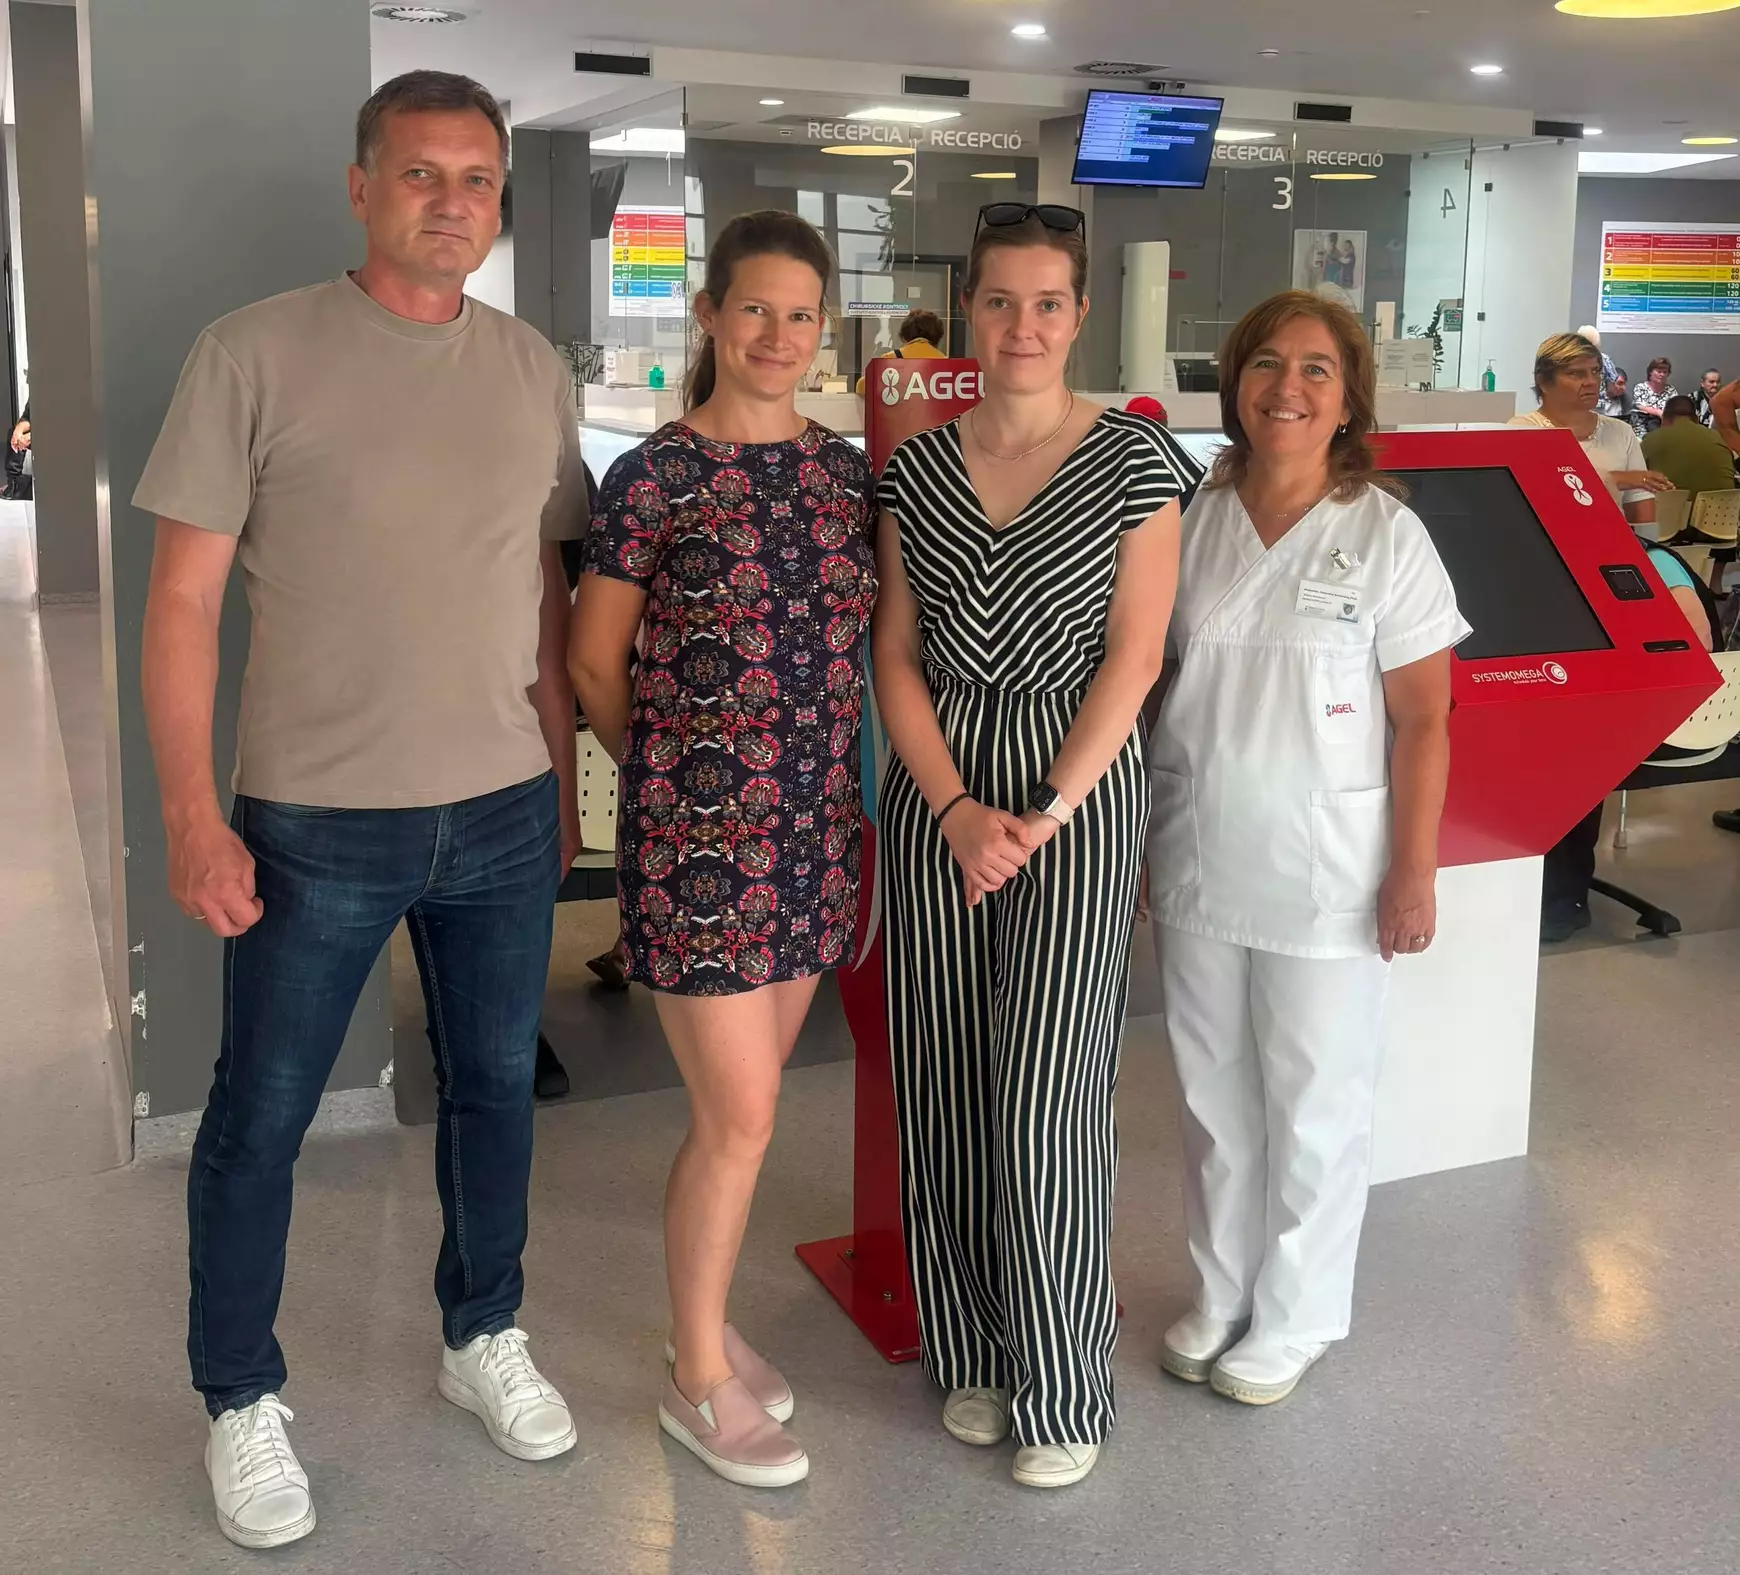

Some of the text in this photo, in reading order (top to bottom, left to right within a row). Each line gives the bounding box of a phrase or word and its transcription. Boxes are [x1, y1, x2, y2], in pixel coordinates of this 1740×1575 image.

[807, 122, 903, 143] RECEPCIA
[931, 129, 1022, 150] RECEPCIÓ
[1306, 149, 1384, 168] RECEPCIÓ
[890, 159, 914, 196] 2
[1272, 177, 1292, 210] 3
[1607, 237, 1613, 245] 1
[1605, 252, 1613, 261] 2
[1605, 268, 1612, 276] 3
[1603, 283, 1611, 292] 4
[1603, 300, 1610, 308] 5
[1471, 668, 1545, 683] SYSTEMOMEGA
[1331, 703, 1357, 715] AGEL
